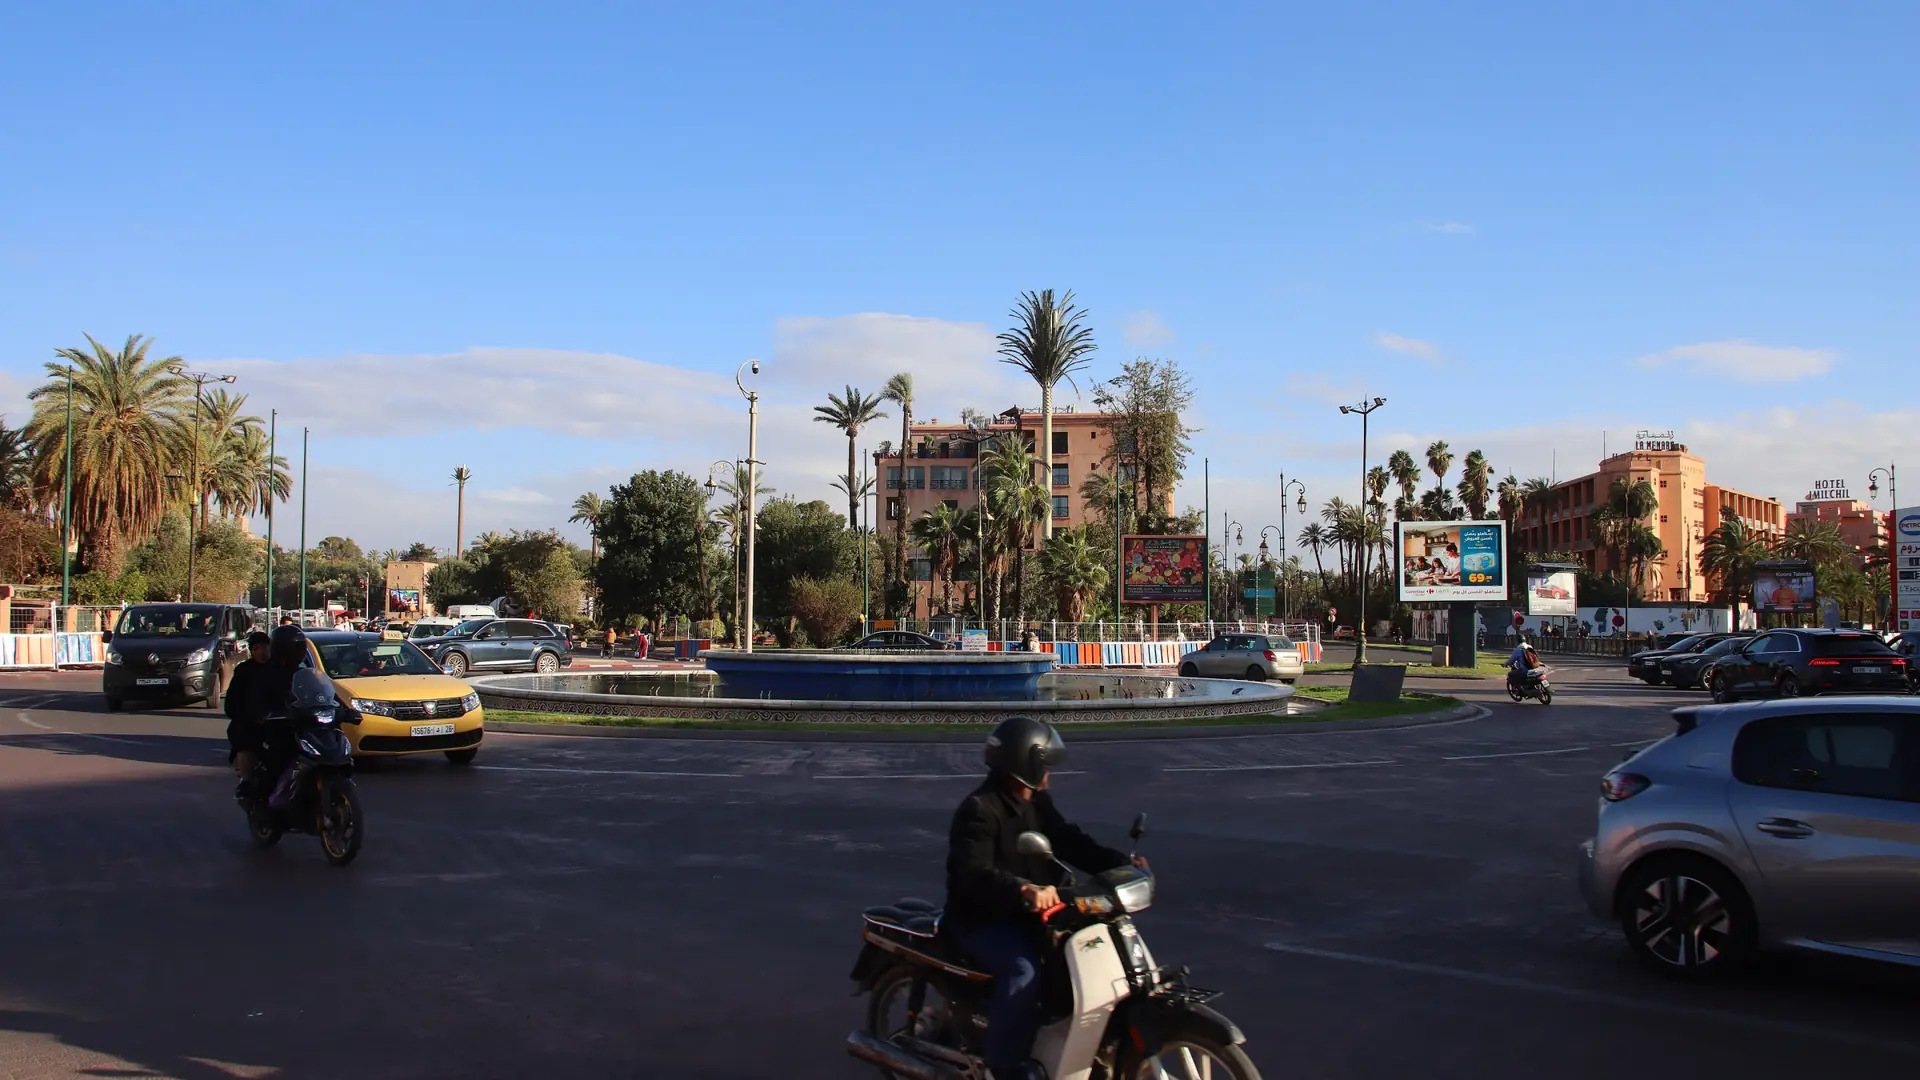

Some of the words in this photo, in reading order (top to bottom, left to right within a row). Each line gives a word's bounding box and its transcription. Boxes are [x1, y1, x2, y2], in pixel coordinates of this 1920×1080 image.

[1636, 441, 1644, 450] LA
[1815, 479, 1845, 489] HOTEL
[1809, 489, 1850, 499] IMILCHIL
